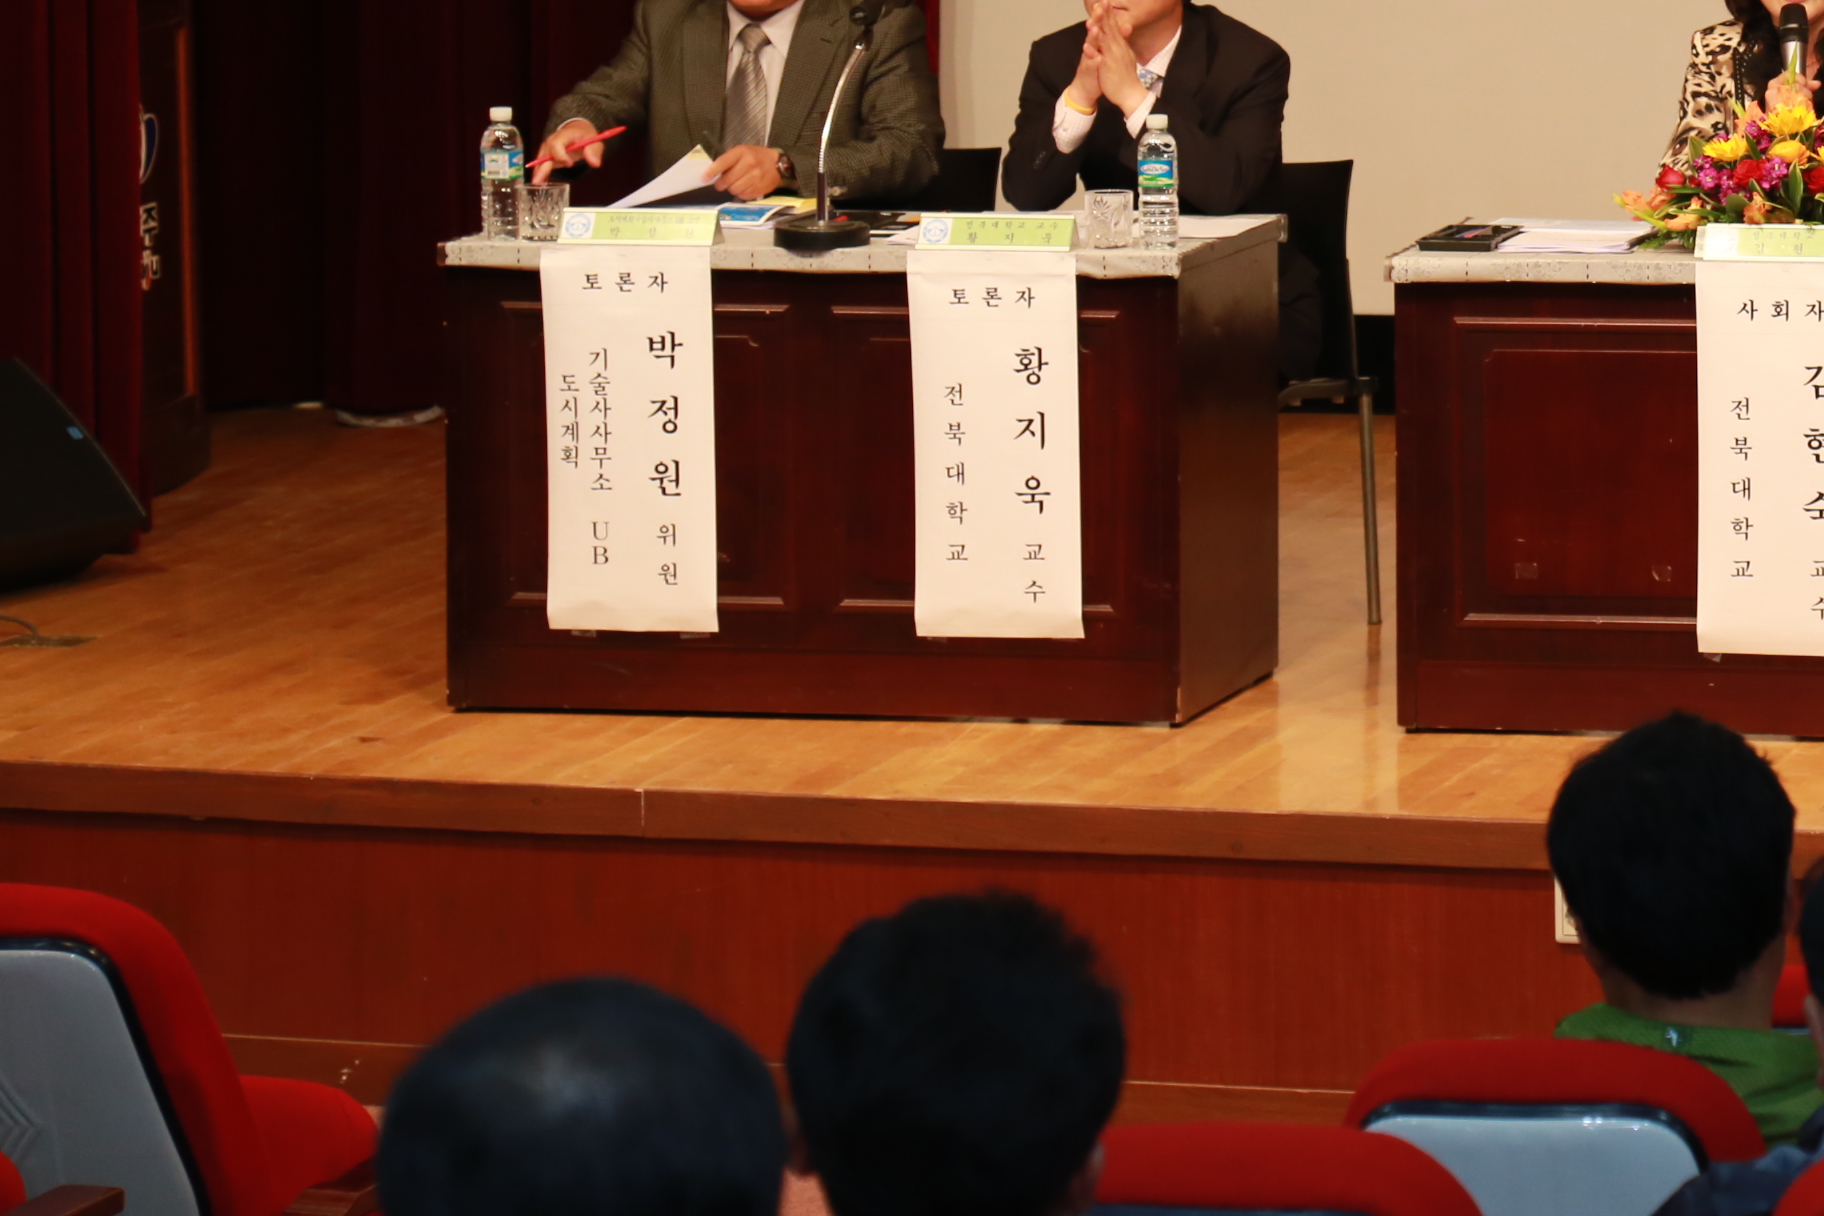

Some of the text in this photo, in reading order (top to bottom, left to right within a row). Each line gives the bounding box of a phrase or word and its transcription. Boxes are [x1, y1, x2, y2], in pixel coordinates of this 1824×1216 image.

[559, 374, 580, 469] 도시계획
[589, 347, 613, 491] 기술사사무소
[647, 331, 684, 586] 박정원 위원
[944, 382, 969, 561] 전북대학교
[1014, 346, 1051, 604] 황지욱 교수
[1730, 397, 1754, 578] 전북대학교
